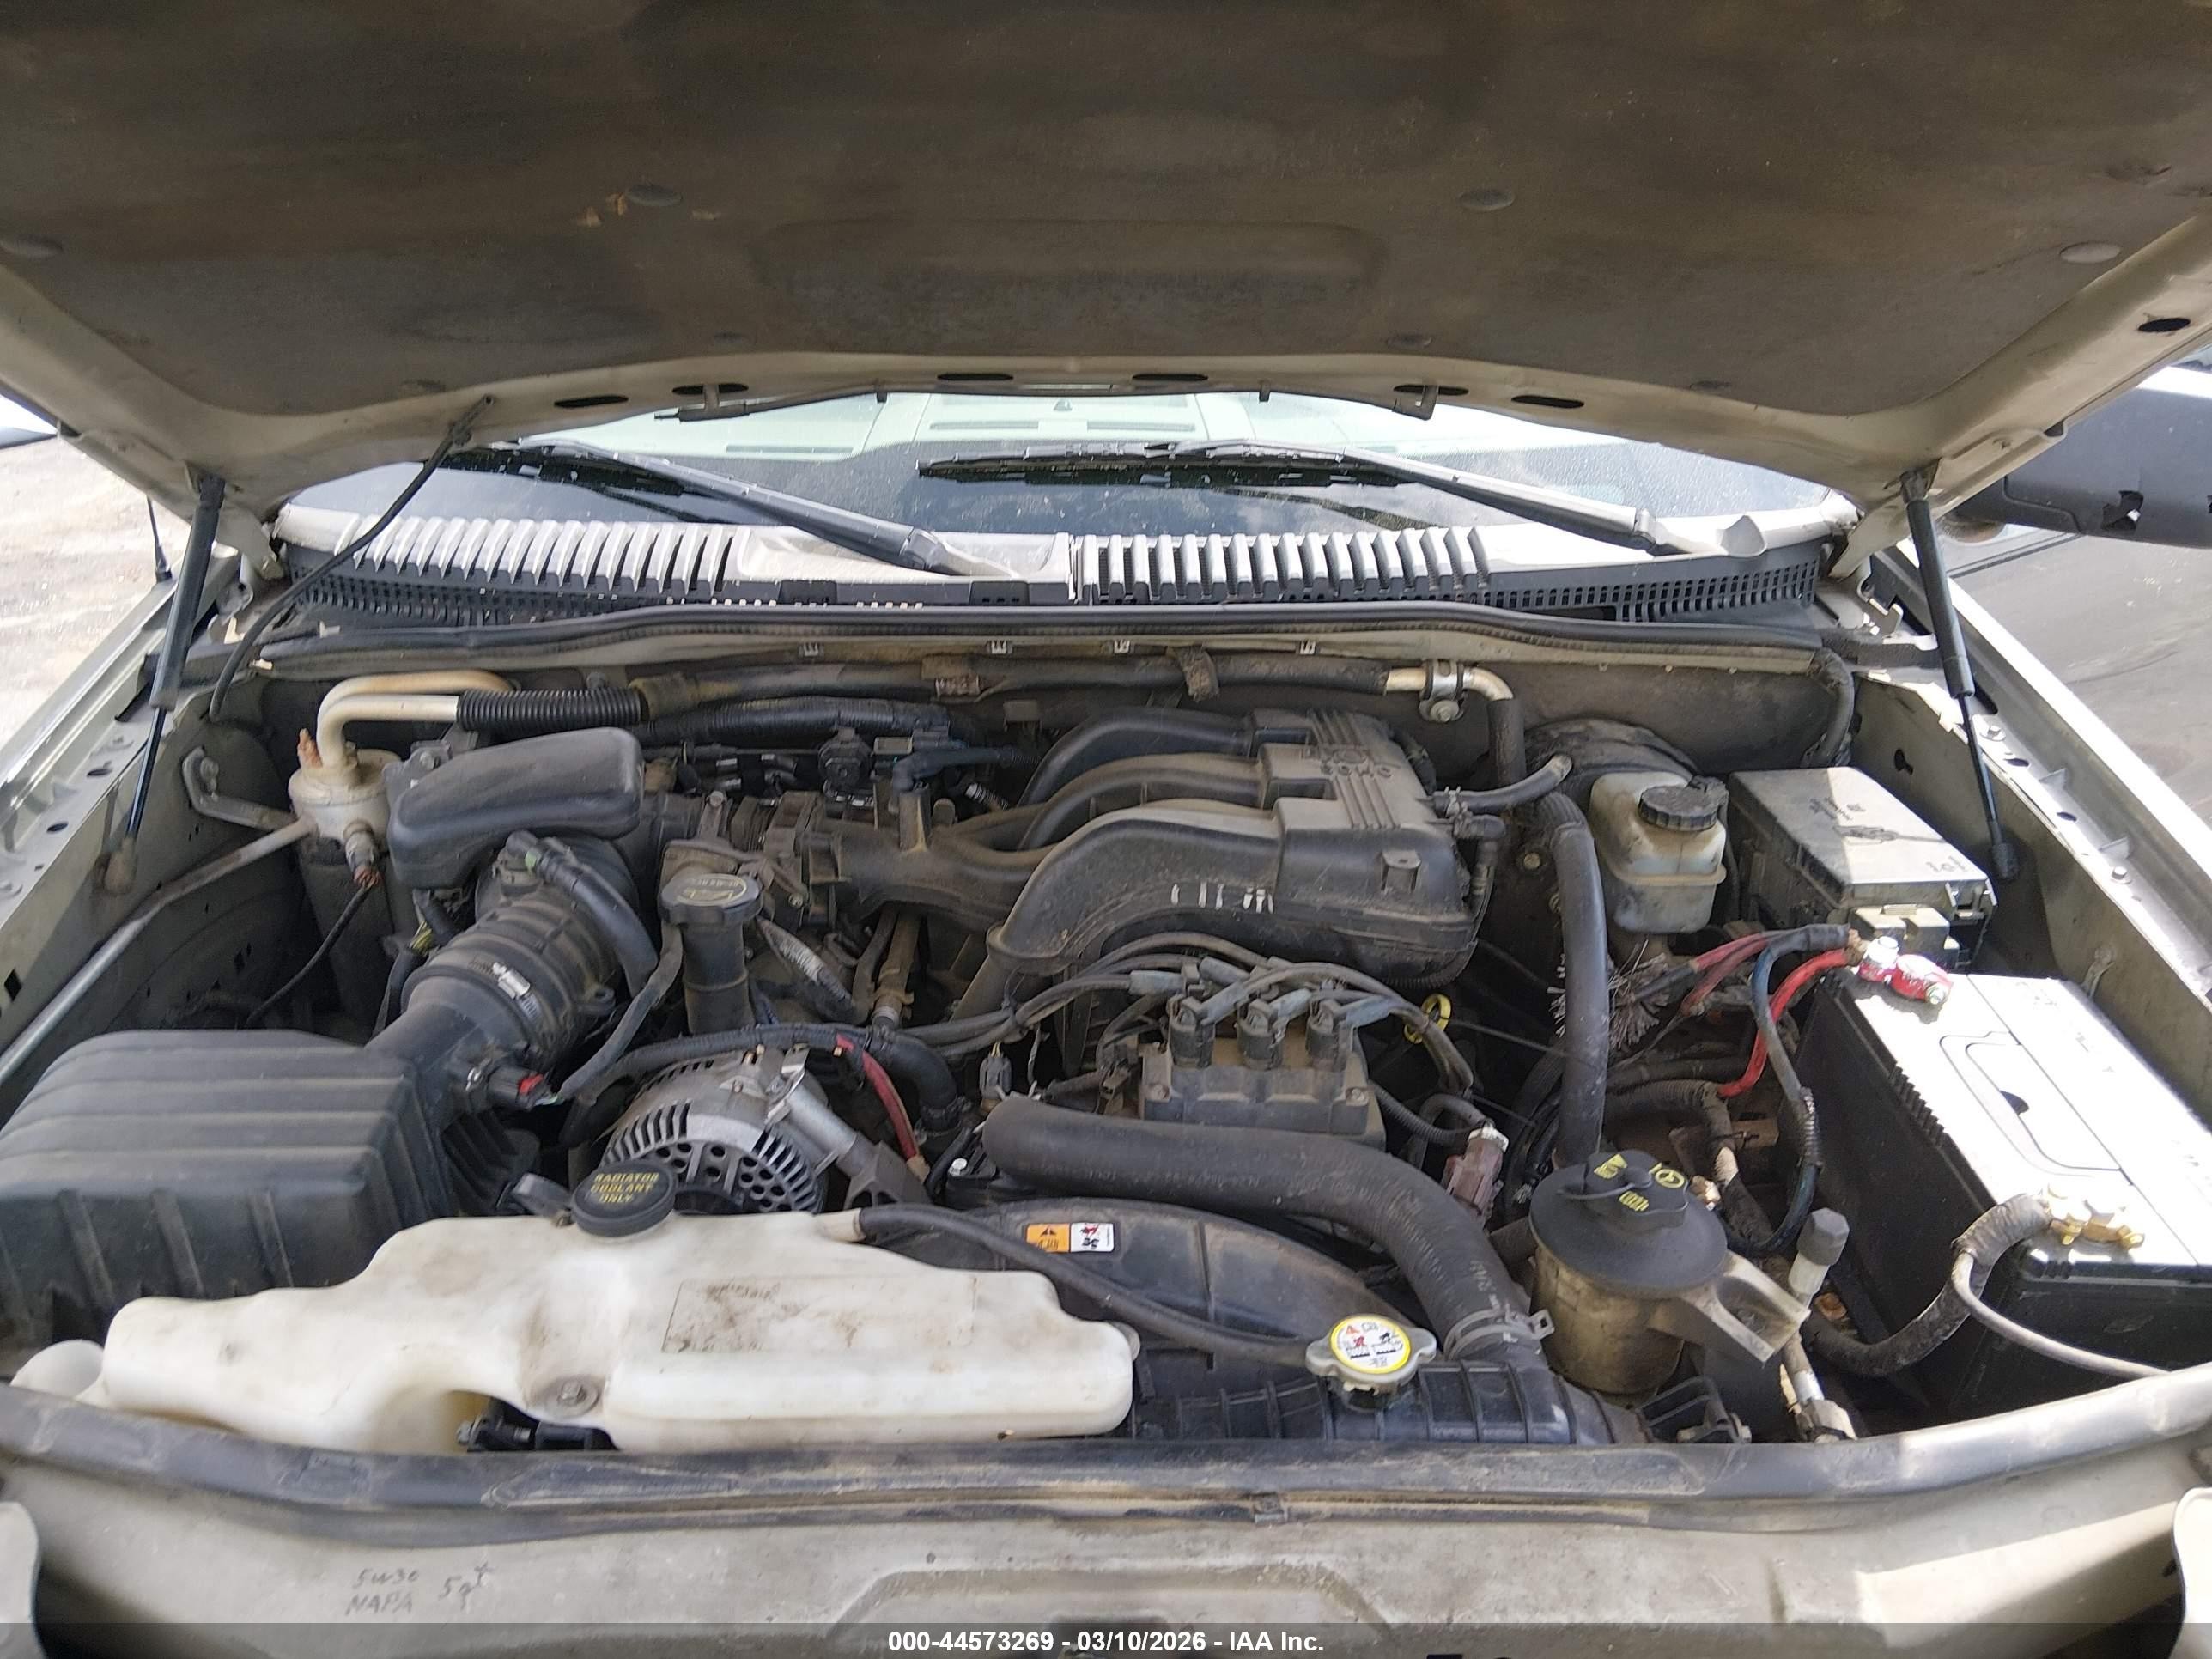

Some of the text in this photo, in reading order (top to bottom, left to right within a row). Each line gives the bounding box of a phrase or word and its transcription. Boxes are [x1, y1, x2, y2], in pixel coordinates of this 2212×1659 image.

[593, 1172, 660, 1183] RADIATOR
[590, 1184, 653, 1193] COOLANT
[599, 1194, 634, 1203] ONLY
